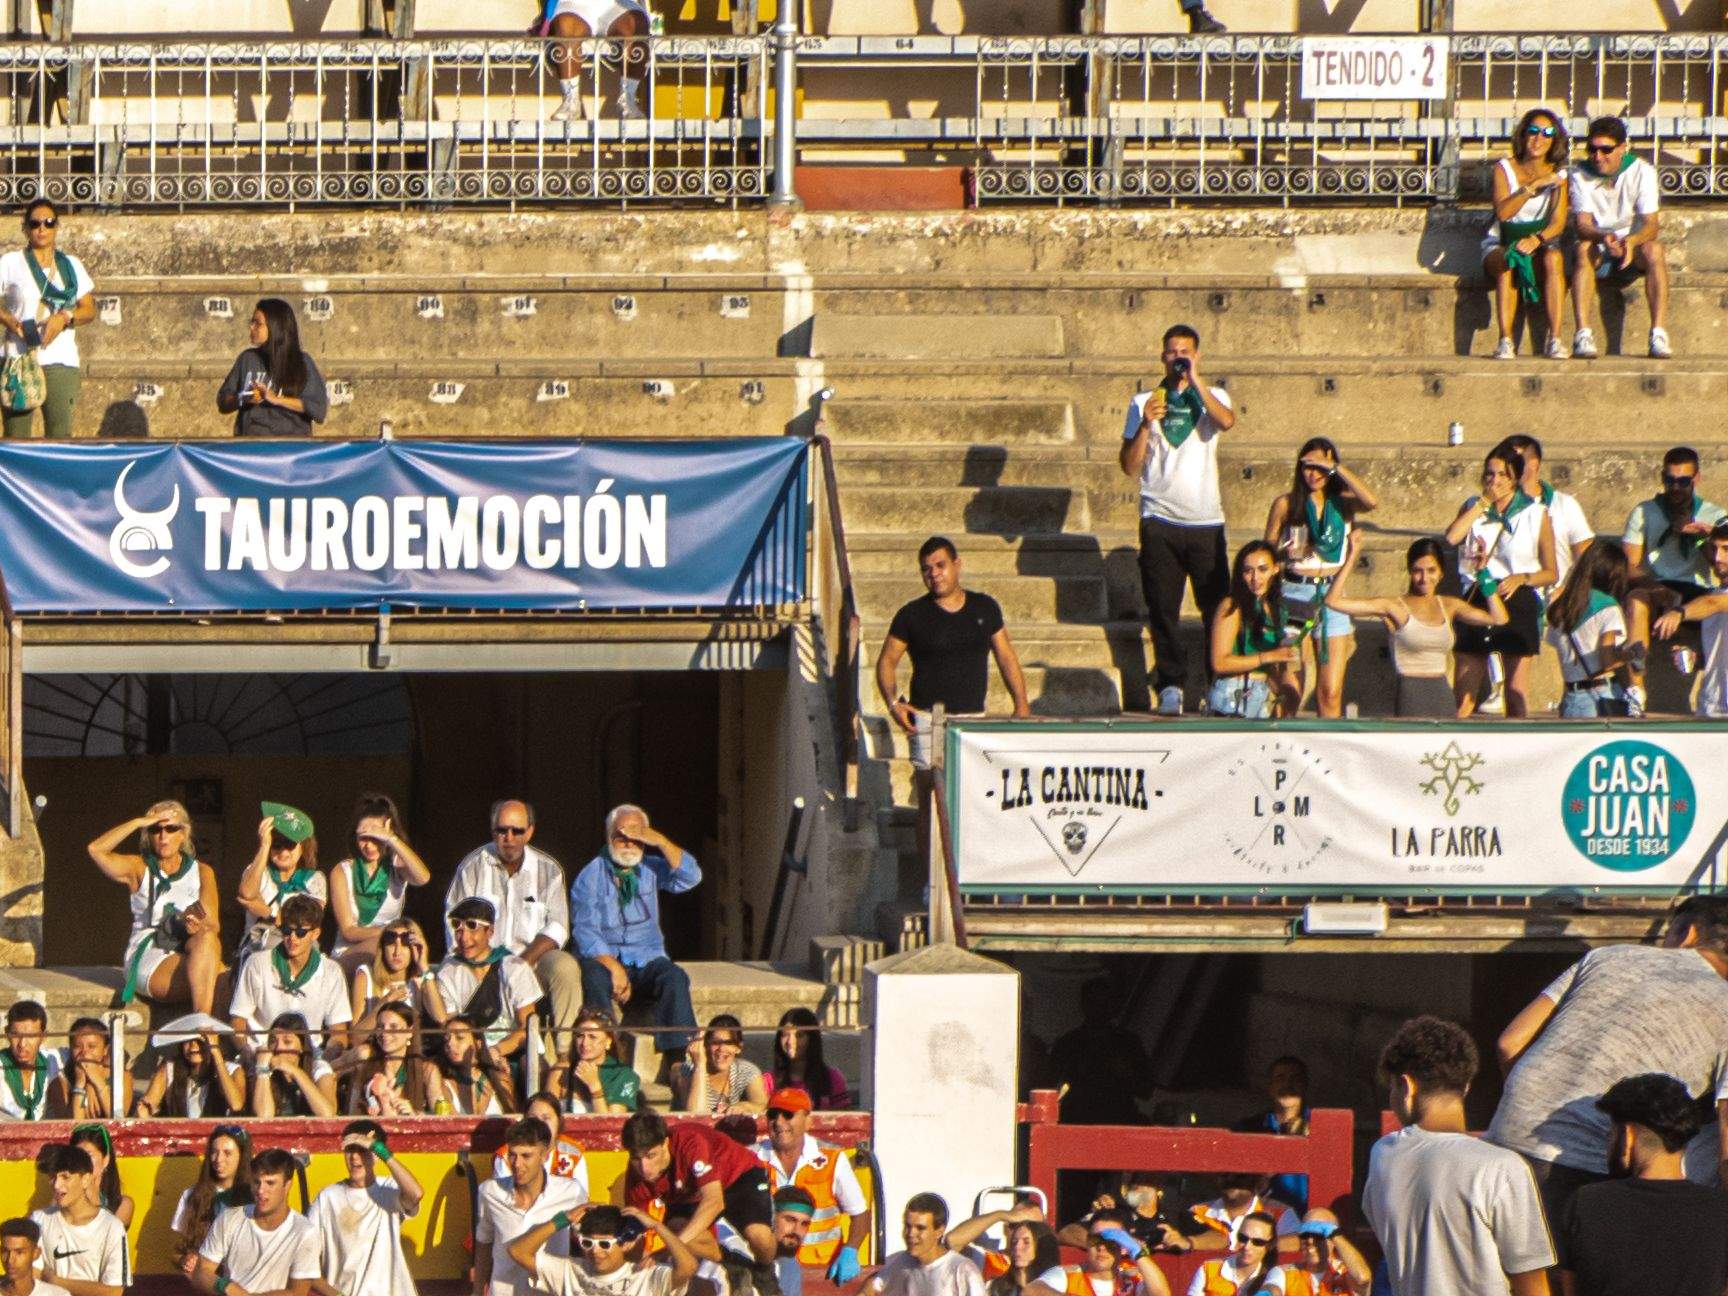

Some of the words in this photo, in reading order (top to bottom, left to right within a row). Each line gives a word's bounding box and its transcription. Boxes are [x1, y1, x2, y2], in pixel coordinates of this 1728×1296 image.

[1311, 50, 1403, 87] TENDIDO
[1422, 45, 1435, 87] 2
[194, 478, 667, 572] TAUROEMOCIÓN
[1001, 767, 1033, 811] LA
[1041, 766, 1149, 811] CANTINA
[1587, 754, 1670, 793] CASA
[1580, 795, 1671, 838] JUAN
[1391, 826, 1420, 858] LA
[1430, 825, 1503, 858] PARRA
[1587, 838, 1631, 856] DESDE
[1635, 838, 1670, 856] 1934
